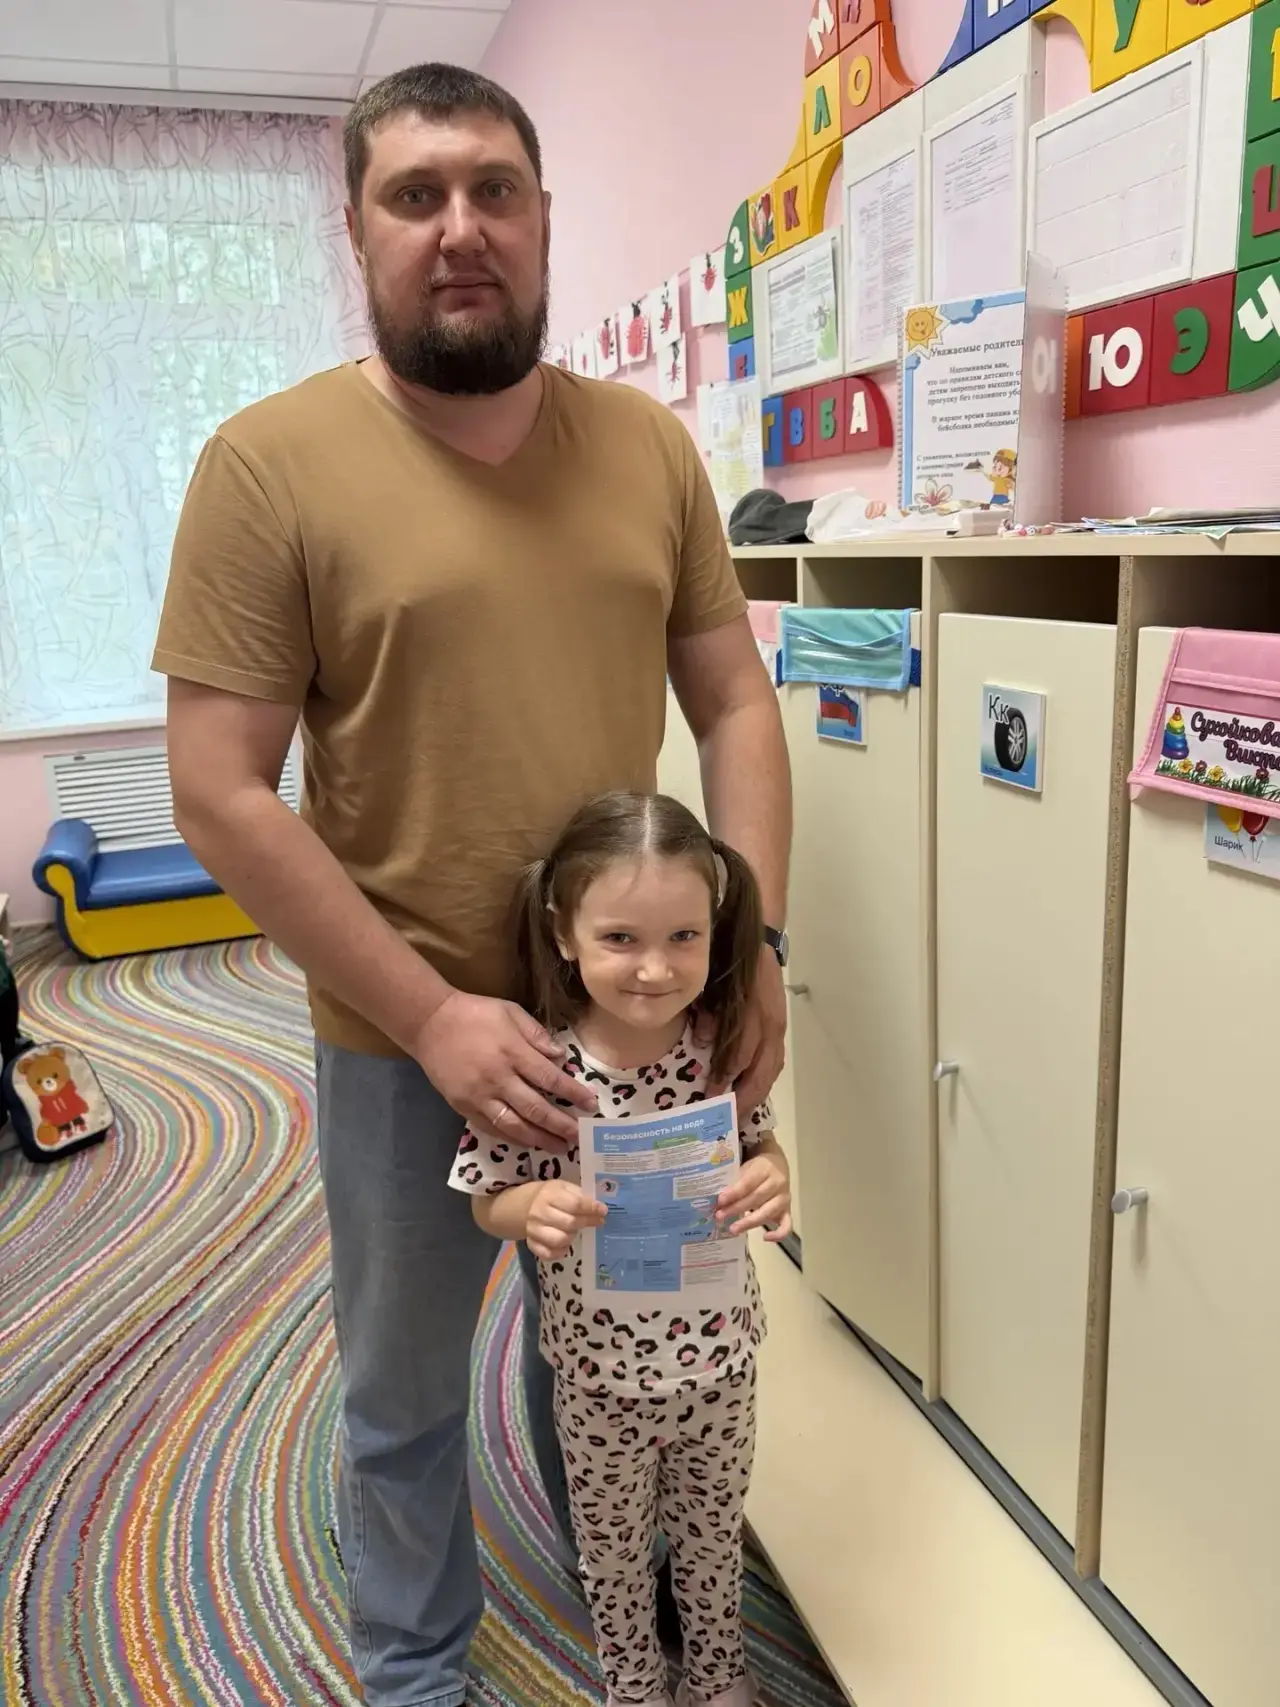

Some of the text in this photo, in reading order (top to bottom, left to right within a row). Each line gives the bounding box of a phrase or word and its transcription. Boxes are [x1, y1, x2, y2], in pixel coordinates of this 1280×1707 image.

[783, 184, 801, 232] К
[728, 286, 748, 328] Ж
[931, 344, 981, 357] Уважаемые
[1089, 306, 1210, 391] Ю Э
[790, 408, 804, 446] В
[820, 398, 836, 440] Б
[850, 391, 868, 435] А
[988, 694, 1009, 724] Кк
[1214, 835, 1243, 851] Шарик
[671, 1125, 682, 1133] на
